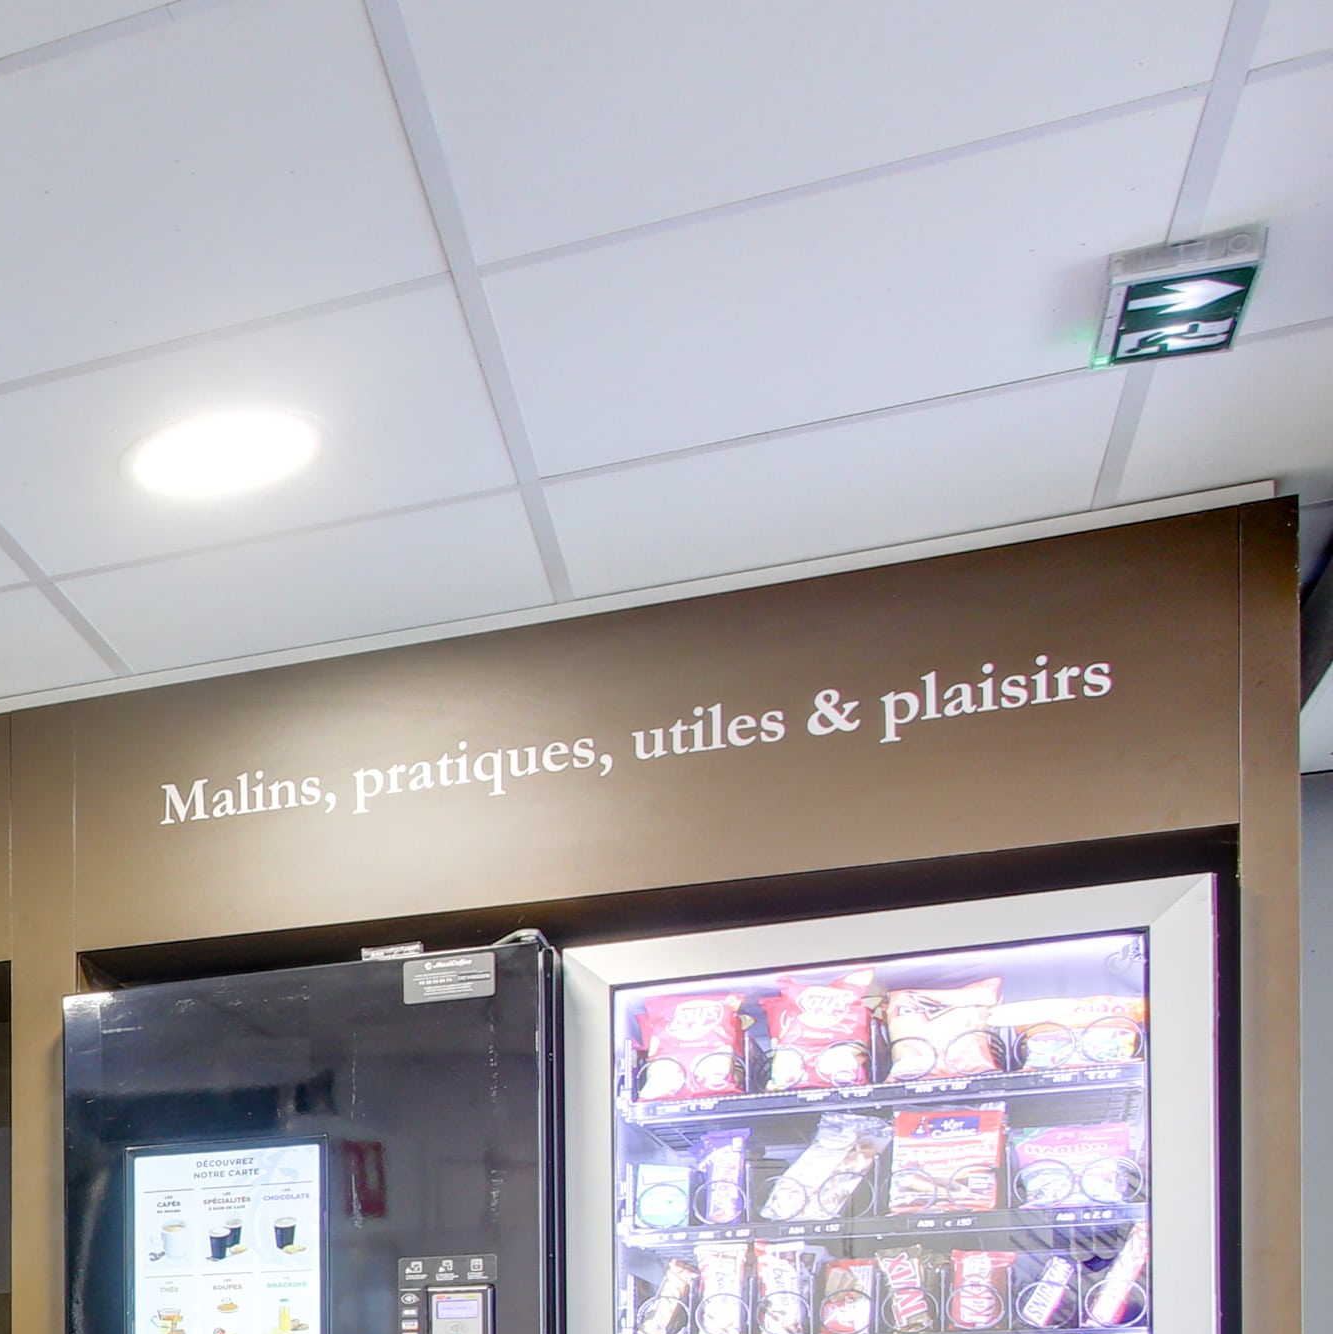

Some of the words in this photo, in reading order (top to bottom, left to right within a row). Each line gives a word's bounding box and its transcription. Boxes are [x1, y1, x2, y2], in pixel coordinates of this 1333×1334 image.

[160, 769, 336, 825] Malins,
[352, 737, 613, 815] pratiques,
[631, 702, 786, 760] utiles
[807, 688, 861, 737] &
[879, 654, 1113, 743] plaisirs
[196, 1157, 255, 1168] DÉCOUVREZ
[193, 1170, 226, 1179] NOTRE
[228, 1167, 261, 1177] CARTE
[203, 1196, 252, 1206] SPÉCIALITÉS
[262, 1193, 310, 1202] CHOCOLATS
[156, 1199, 181, 1208] CAFÉS
[212, 1283, 243, 1291] SOUPES
[883, 1252, 928, 1327] TWIX
